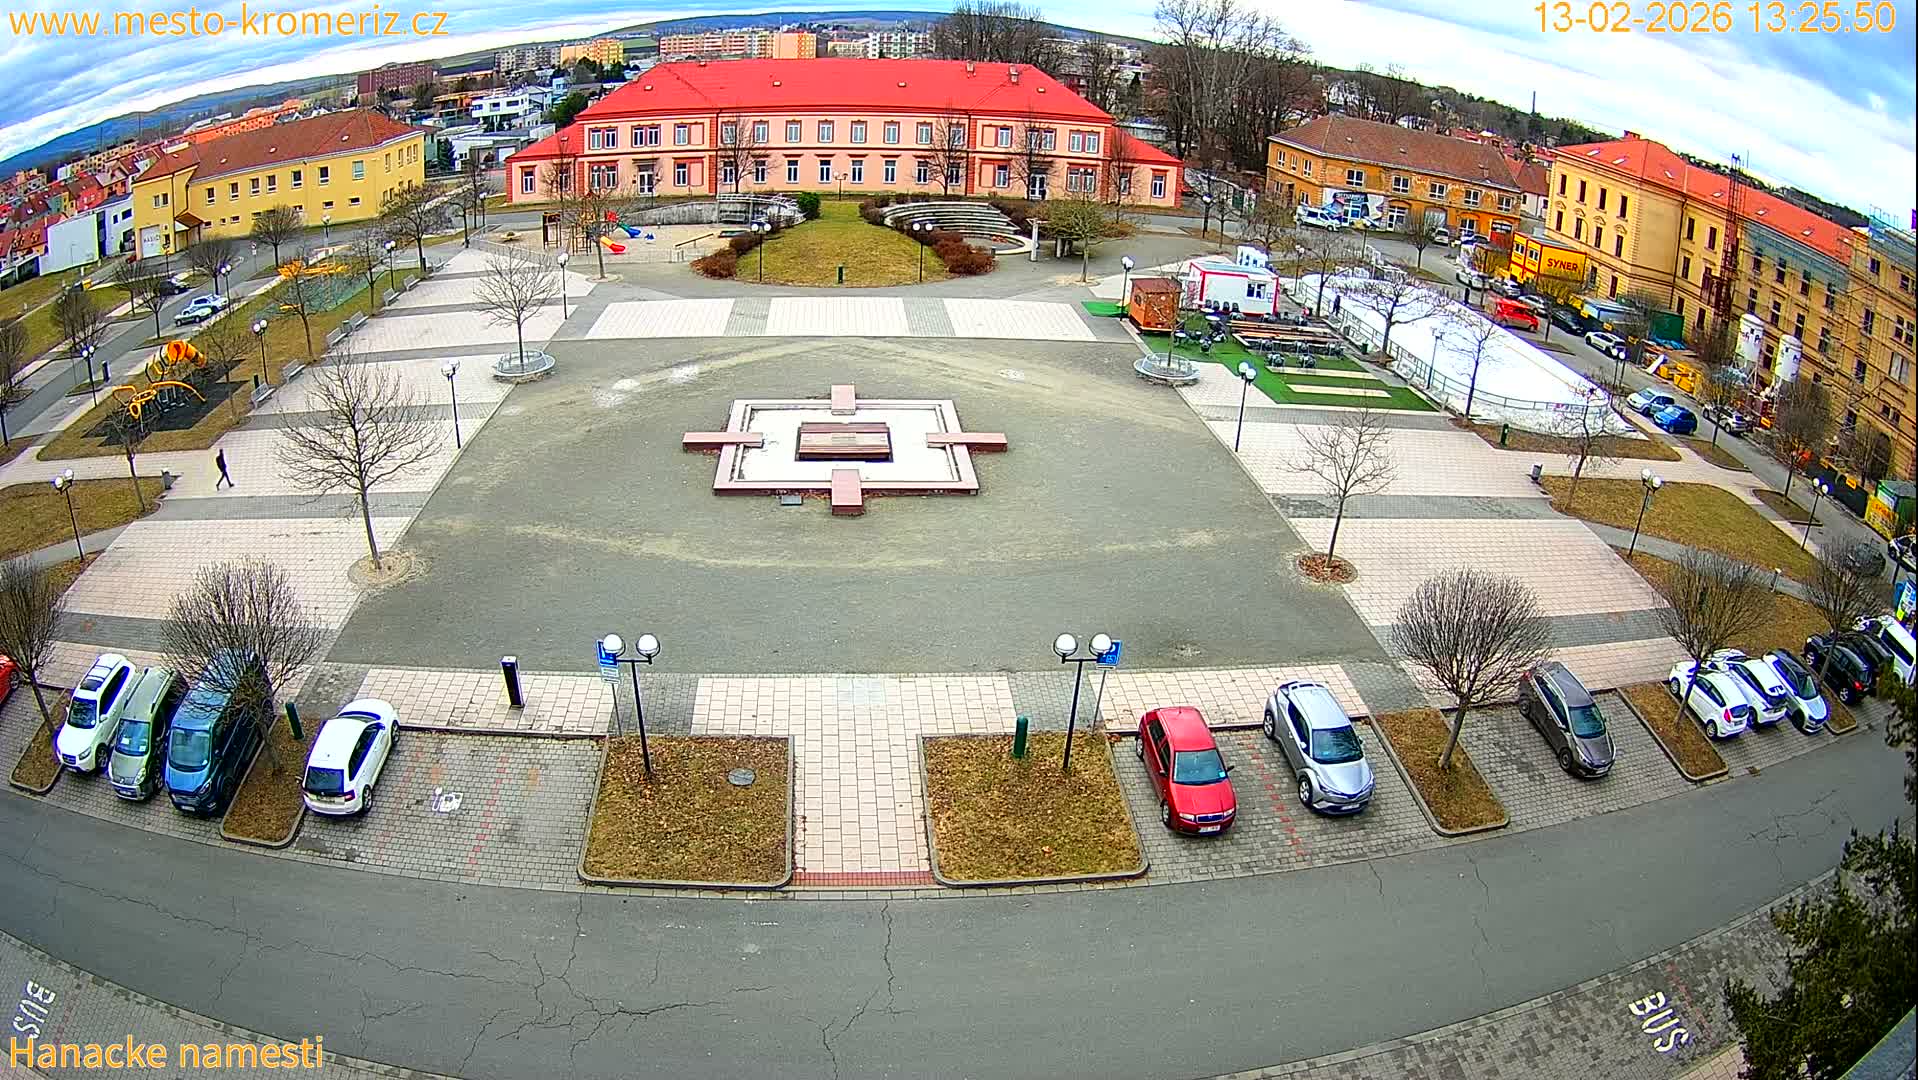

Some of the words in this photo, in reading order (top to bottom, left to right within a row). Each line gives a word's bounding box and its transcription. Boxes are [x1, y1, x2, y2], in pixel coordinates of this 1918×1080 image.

[1547, 258, 1578, 272] SYNER
[13, 980, 56, 1039] BUS
[1628, 991, 1689, 1052] BUS
